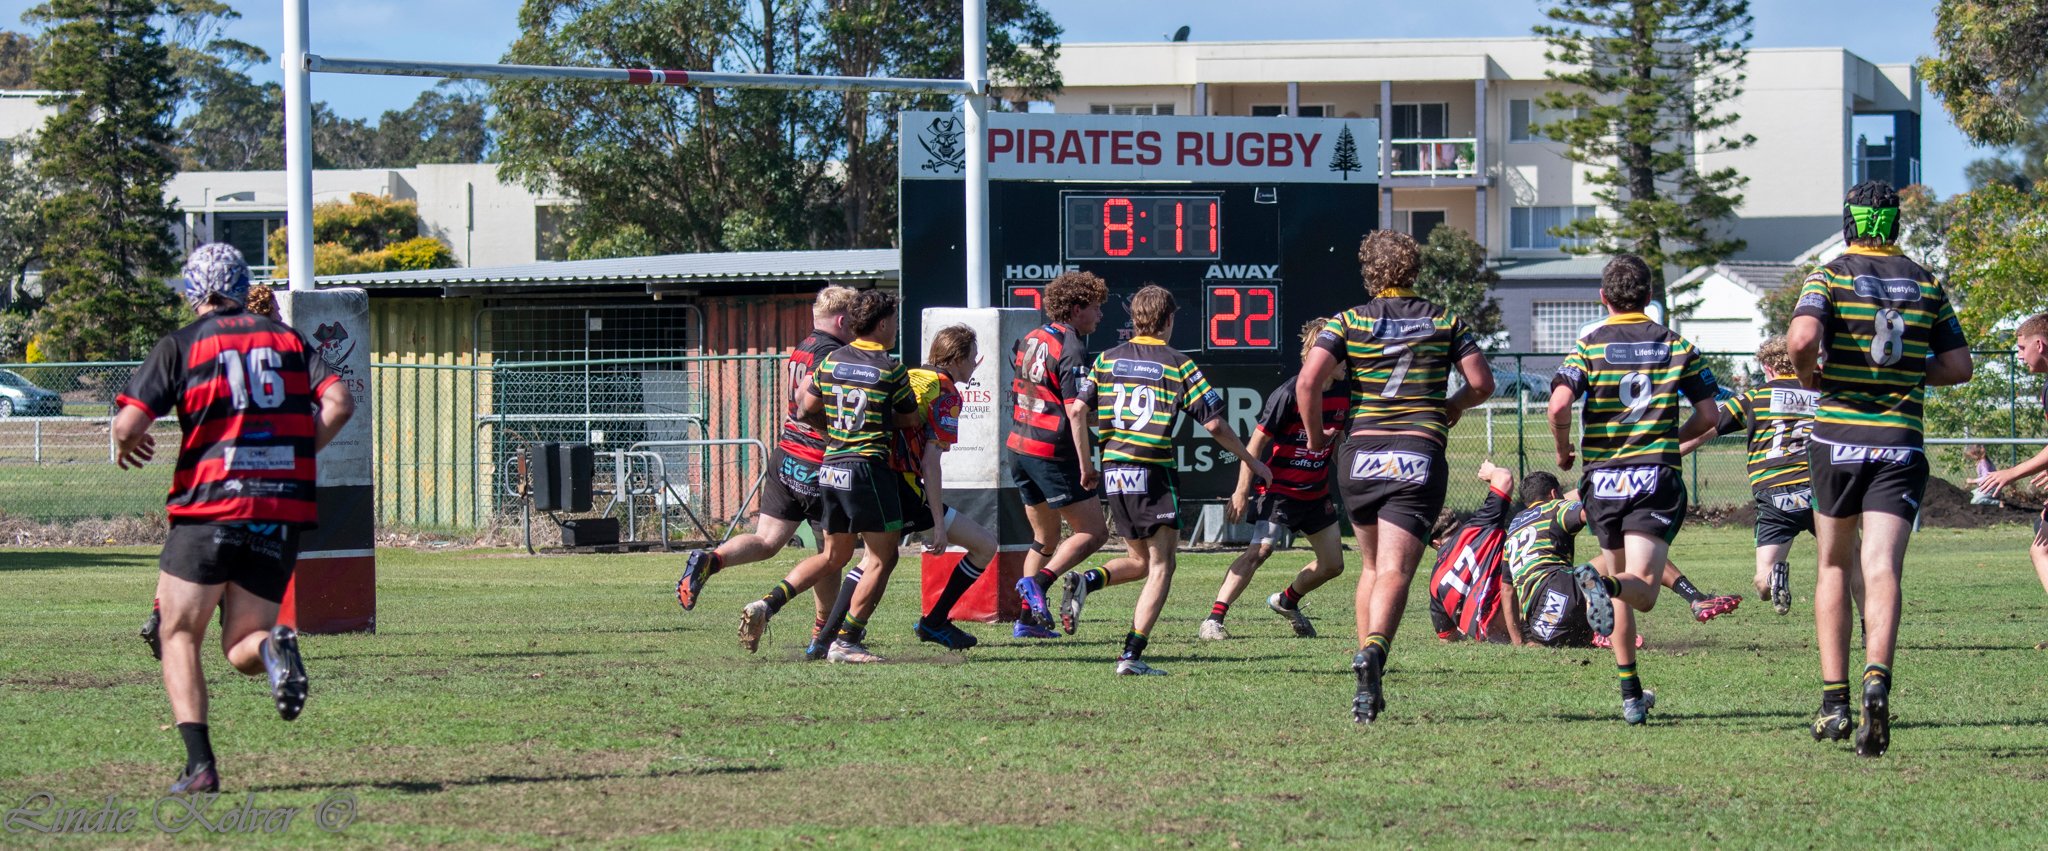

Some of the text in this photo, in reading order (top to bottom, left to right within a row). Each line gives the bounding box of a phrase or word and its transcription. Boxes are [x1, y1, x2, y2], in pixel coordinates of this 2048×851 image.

[987, 128, 1322, 168] PIRATES RUGBY
[1103, 198, 1217, 257] 8:11
[1205, 264, 1279, 279] AWAY
[1210, 289, 1274, 347] 22
[1870, 308, 1905, 366] 8
[219, 347, 286, 410] 16
[1022, 337, 1049, 383] 18
[1380, 345, 1415, 398] 7
[831, 384, 867, 431] 13
[1111, 383, 1156, 432] 19
[1619, 371, 1652, 424] 9
[1440, 544, 1481, 597] 17
[1508, 525, 1540, 577] 22
